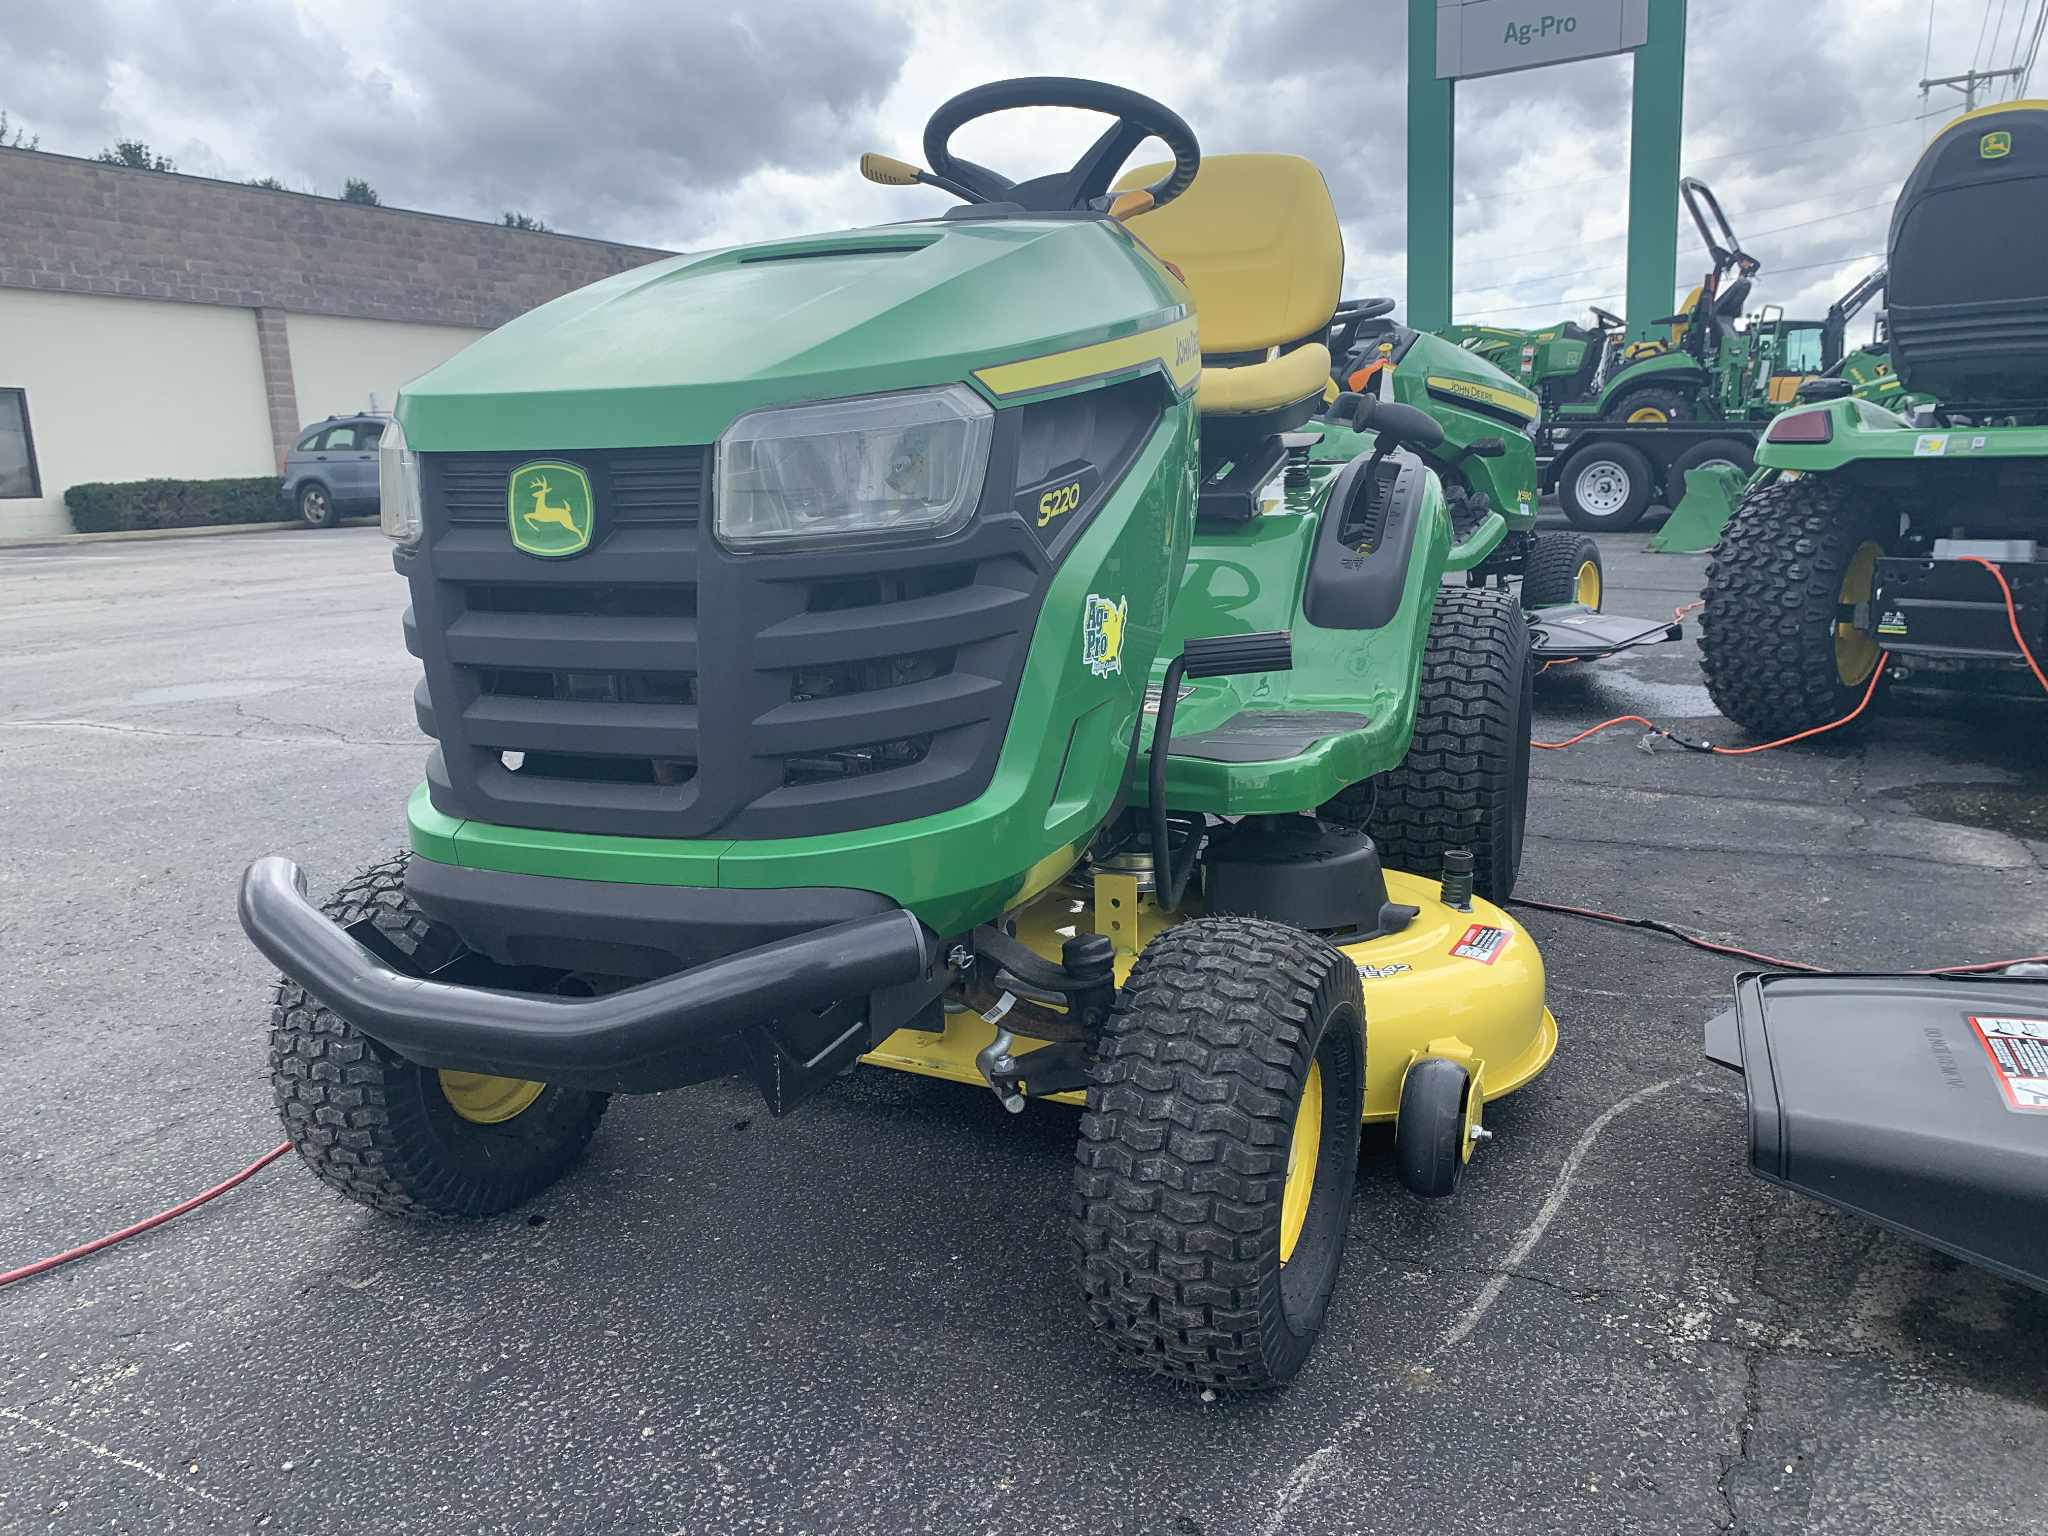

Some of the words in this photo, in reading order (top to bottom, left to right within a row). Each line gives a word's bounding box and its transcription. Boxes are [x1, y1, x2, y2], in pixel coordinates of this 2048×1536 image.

[1504, 15, 1577, 45] Ag-Pro
[1450, 383, 1471, 395] JOHN
[1038, 483, 1080, 527] S220
